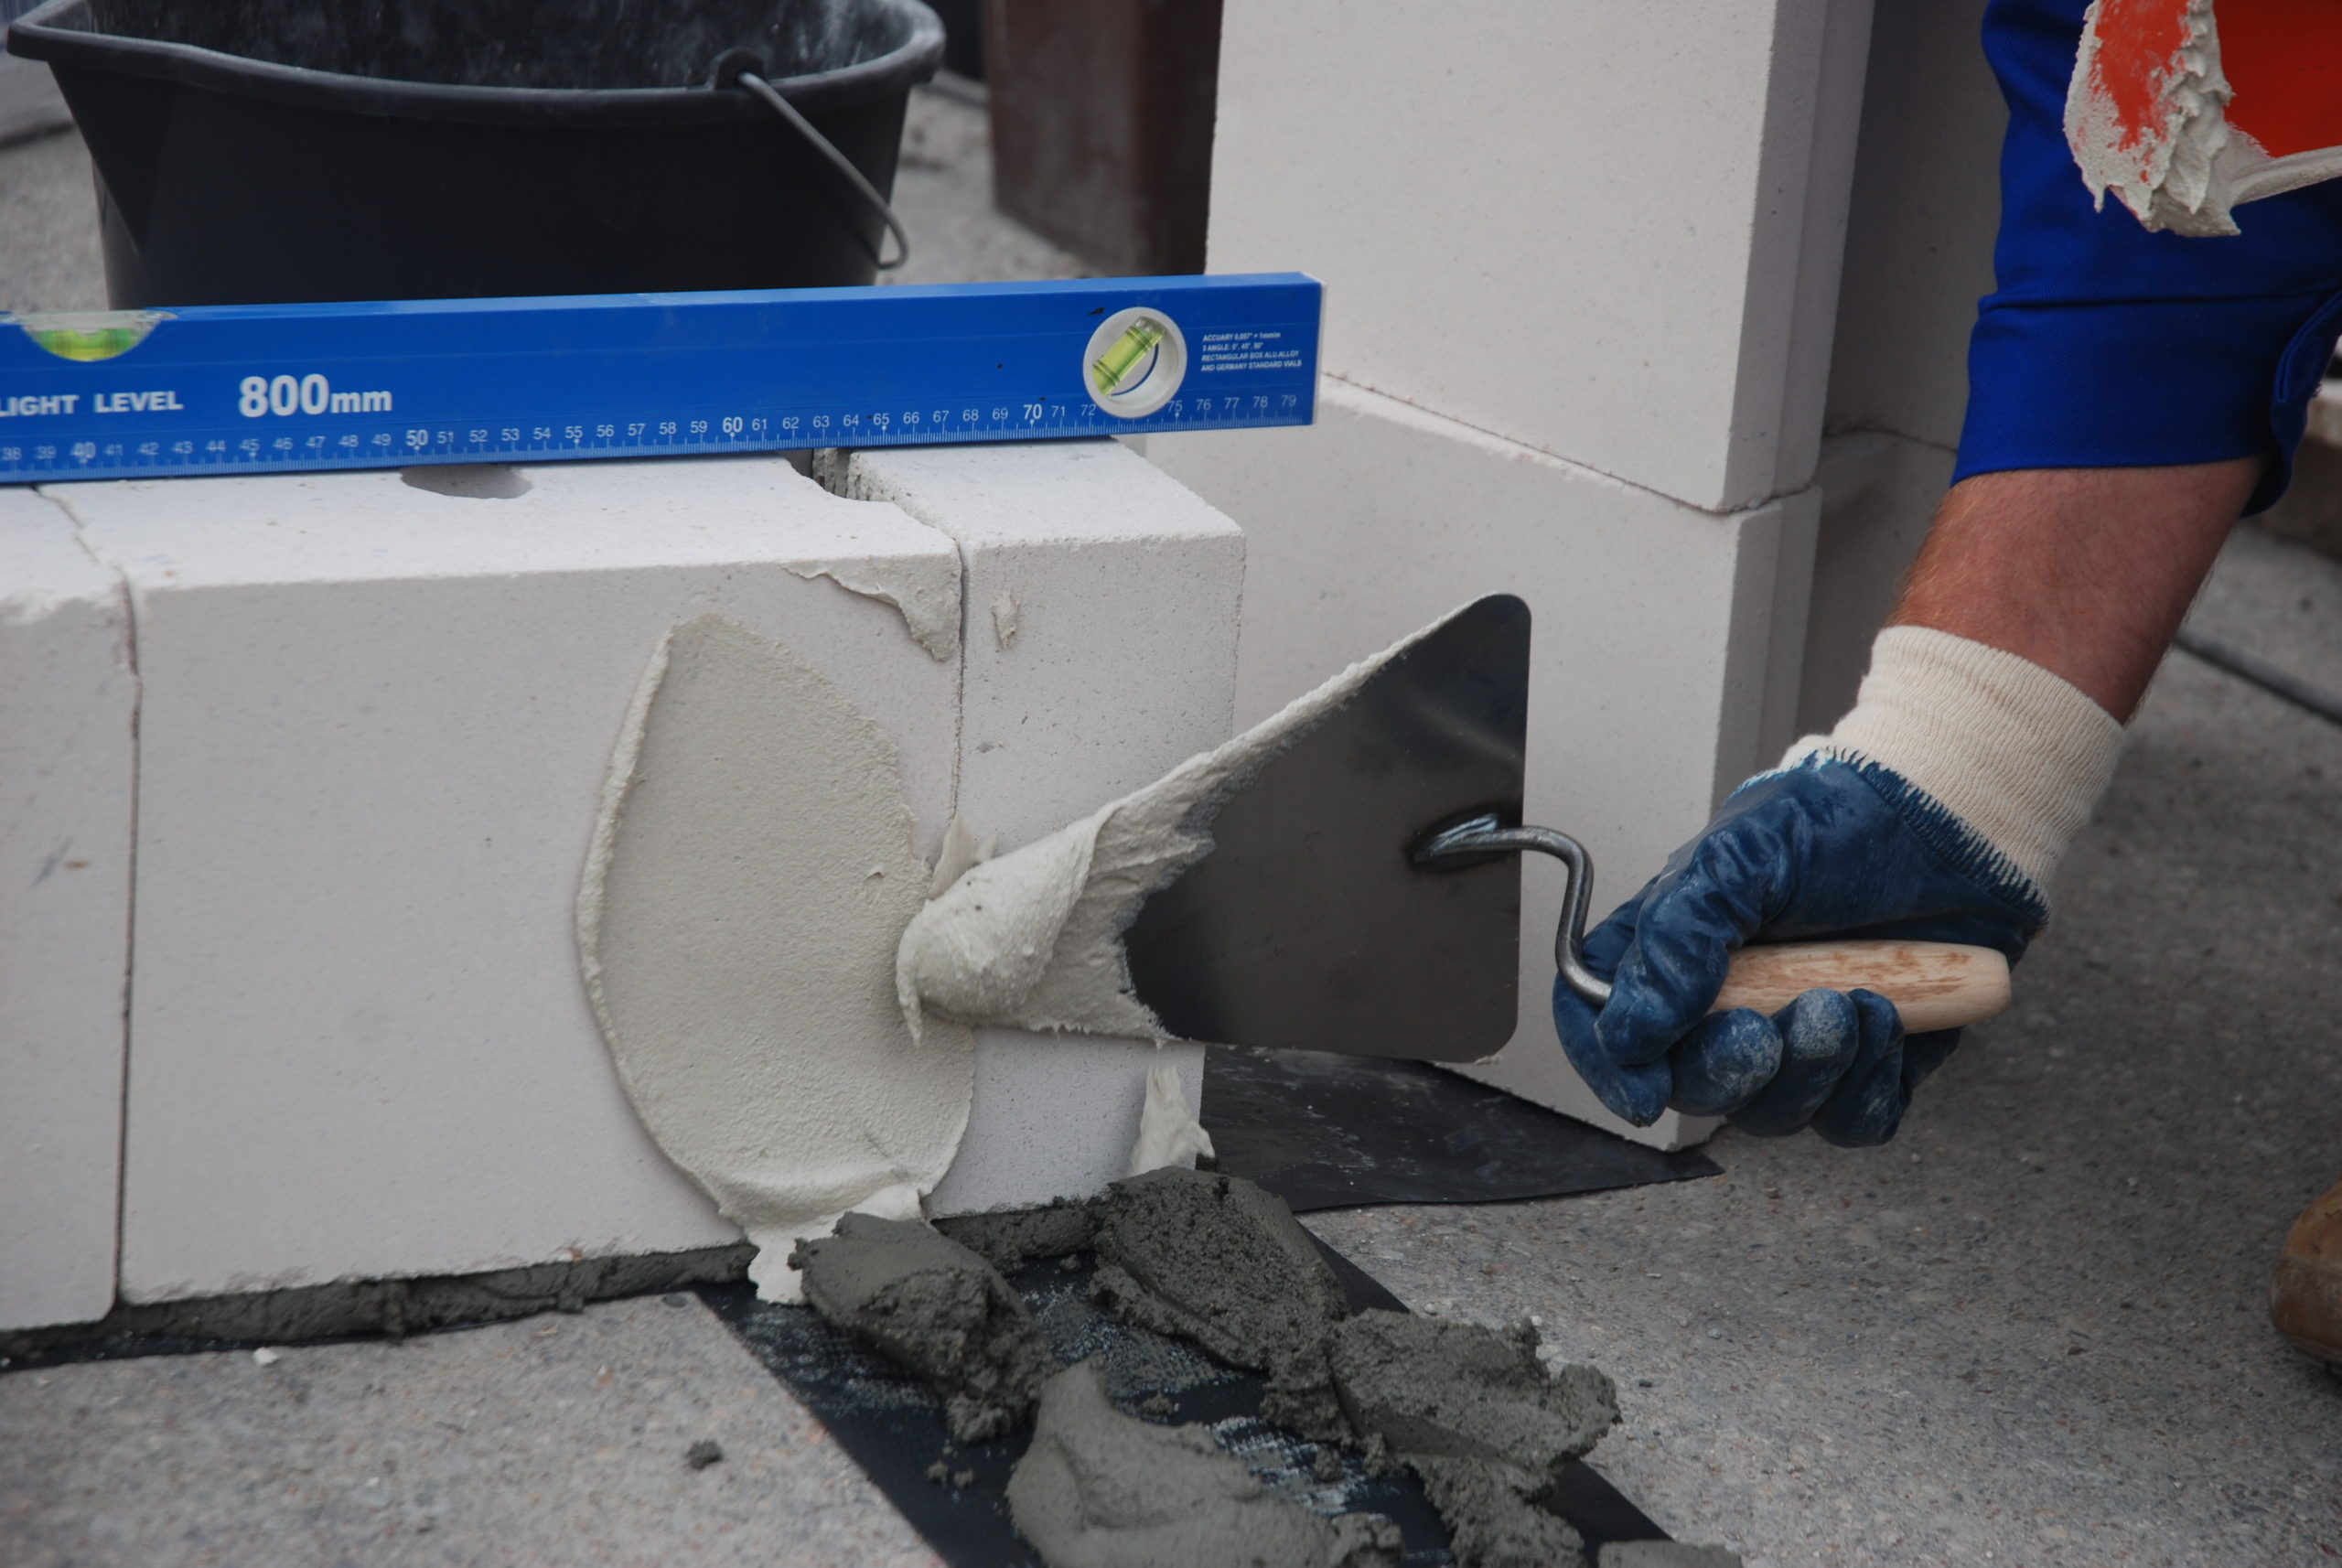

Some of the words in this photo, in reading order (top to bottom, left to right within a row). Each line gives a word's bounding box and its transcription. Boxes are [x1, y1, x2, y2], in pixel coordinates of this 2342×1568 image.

[1201, 353, 1249, 361] RECTANGULAR
[1217, 362, 1247, 371] GERMANY
[1249, 360, 1282, 369] STANDARD
[94, 392, 184, 413] LEVEL
[239, 373, 392, 417] 800mm
[1, 447, 21, 460] 38
[36, 446, 56, 458] 39
[70, 442, 96, 458] 40
[103, 445, 123, 456] 41
[139, 442, 159, 455] 42
[171, 441, 193, 454] 43
[206, 440, 226, 451] 44
[240, 439, 259, 451] 45
[273, 437, 293, 450] 46
[306, 436, 326, 448] 47
[338, 435, 359, 447] 48
[371, 434, 392, 446] 49
[406, 429, 428, 446] 50
[437, 431, 454, 444] 51
[469, 430, 488, 442] 52
[501, 428, 520, 441] 53
[533, 427, 551, 440] 54
[565, 426, 583, 438] 55
[596, 425, 614, 437] 56
[628, 424, 645, 435] 57
[660, 423, 676, 435] 58
[691, 421, 707, 433] 59
[723, 417, 743, 433] 60
[752, 419, 768, 430] 61
[783, 417, 799, 429] 62
[813, 415, 829, 428] 63
[843, 415, 859, 426] 64
[873, 413, 889, 424] 65
[903, 412, 919, 424] 66
[933, 410, 949, 423] 67
[962, 410, 979, 421] 68
[993, 408, 1008, 420] 69
[1024, 404, 1042, 420] 70
[1052, 405, 1065, 417] 71
[1081, 404, 1096, 416] 72
[1167, 401, 1183, 412] 75
[1196, 399, 1211, 411] 76
[1225, 397, 1240, 408] 77
[1253, 396, 1267, 407] 78
[1282, 395, 1295, 406] 79
